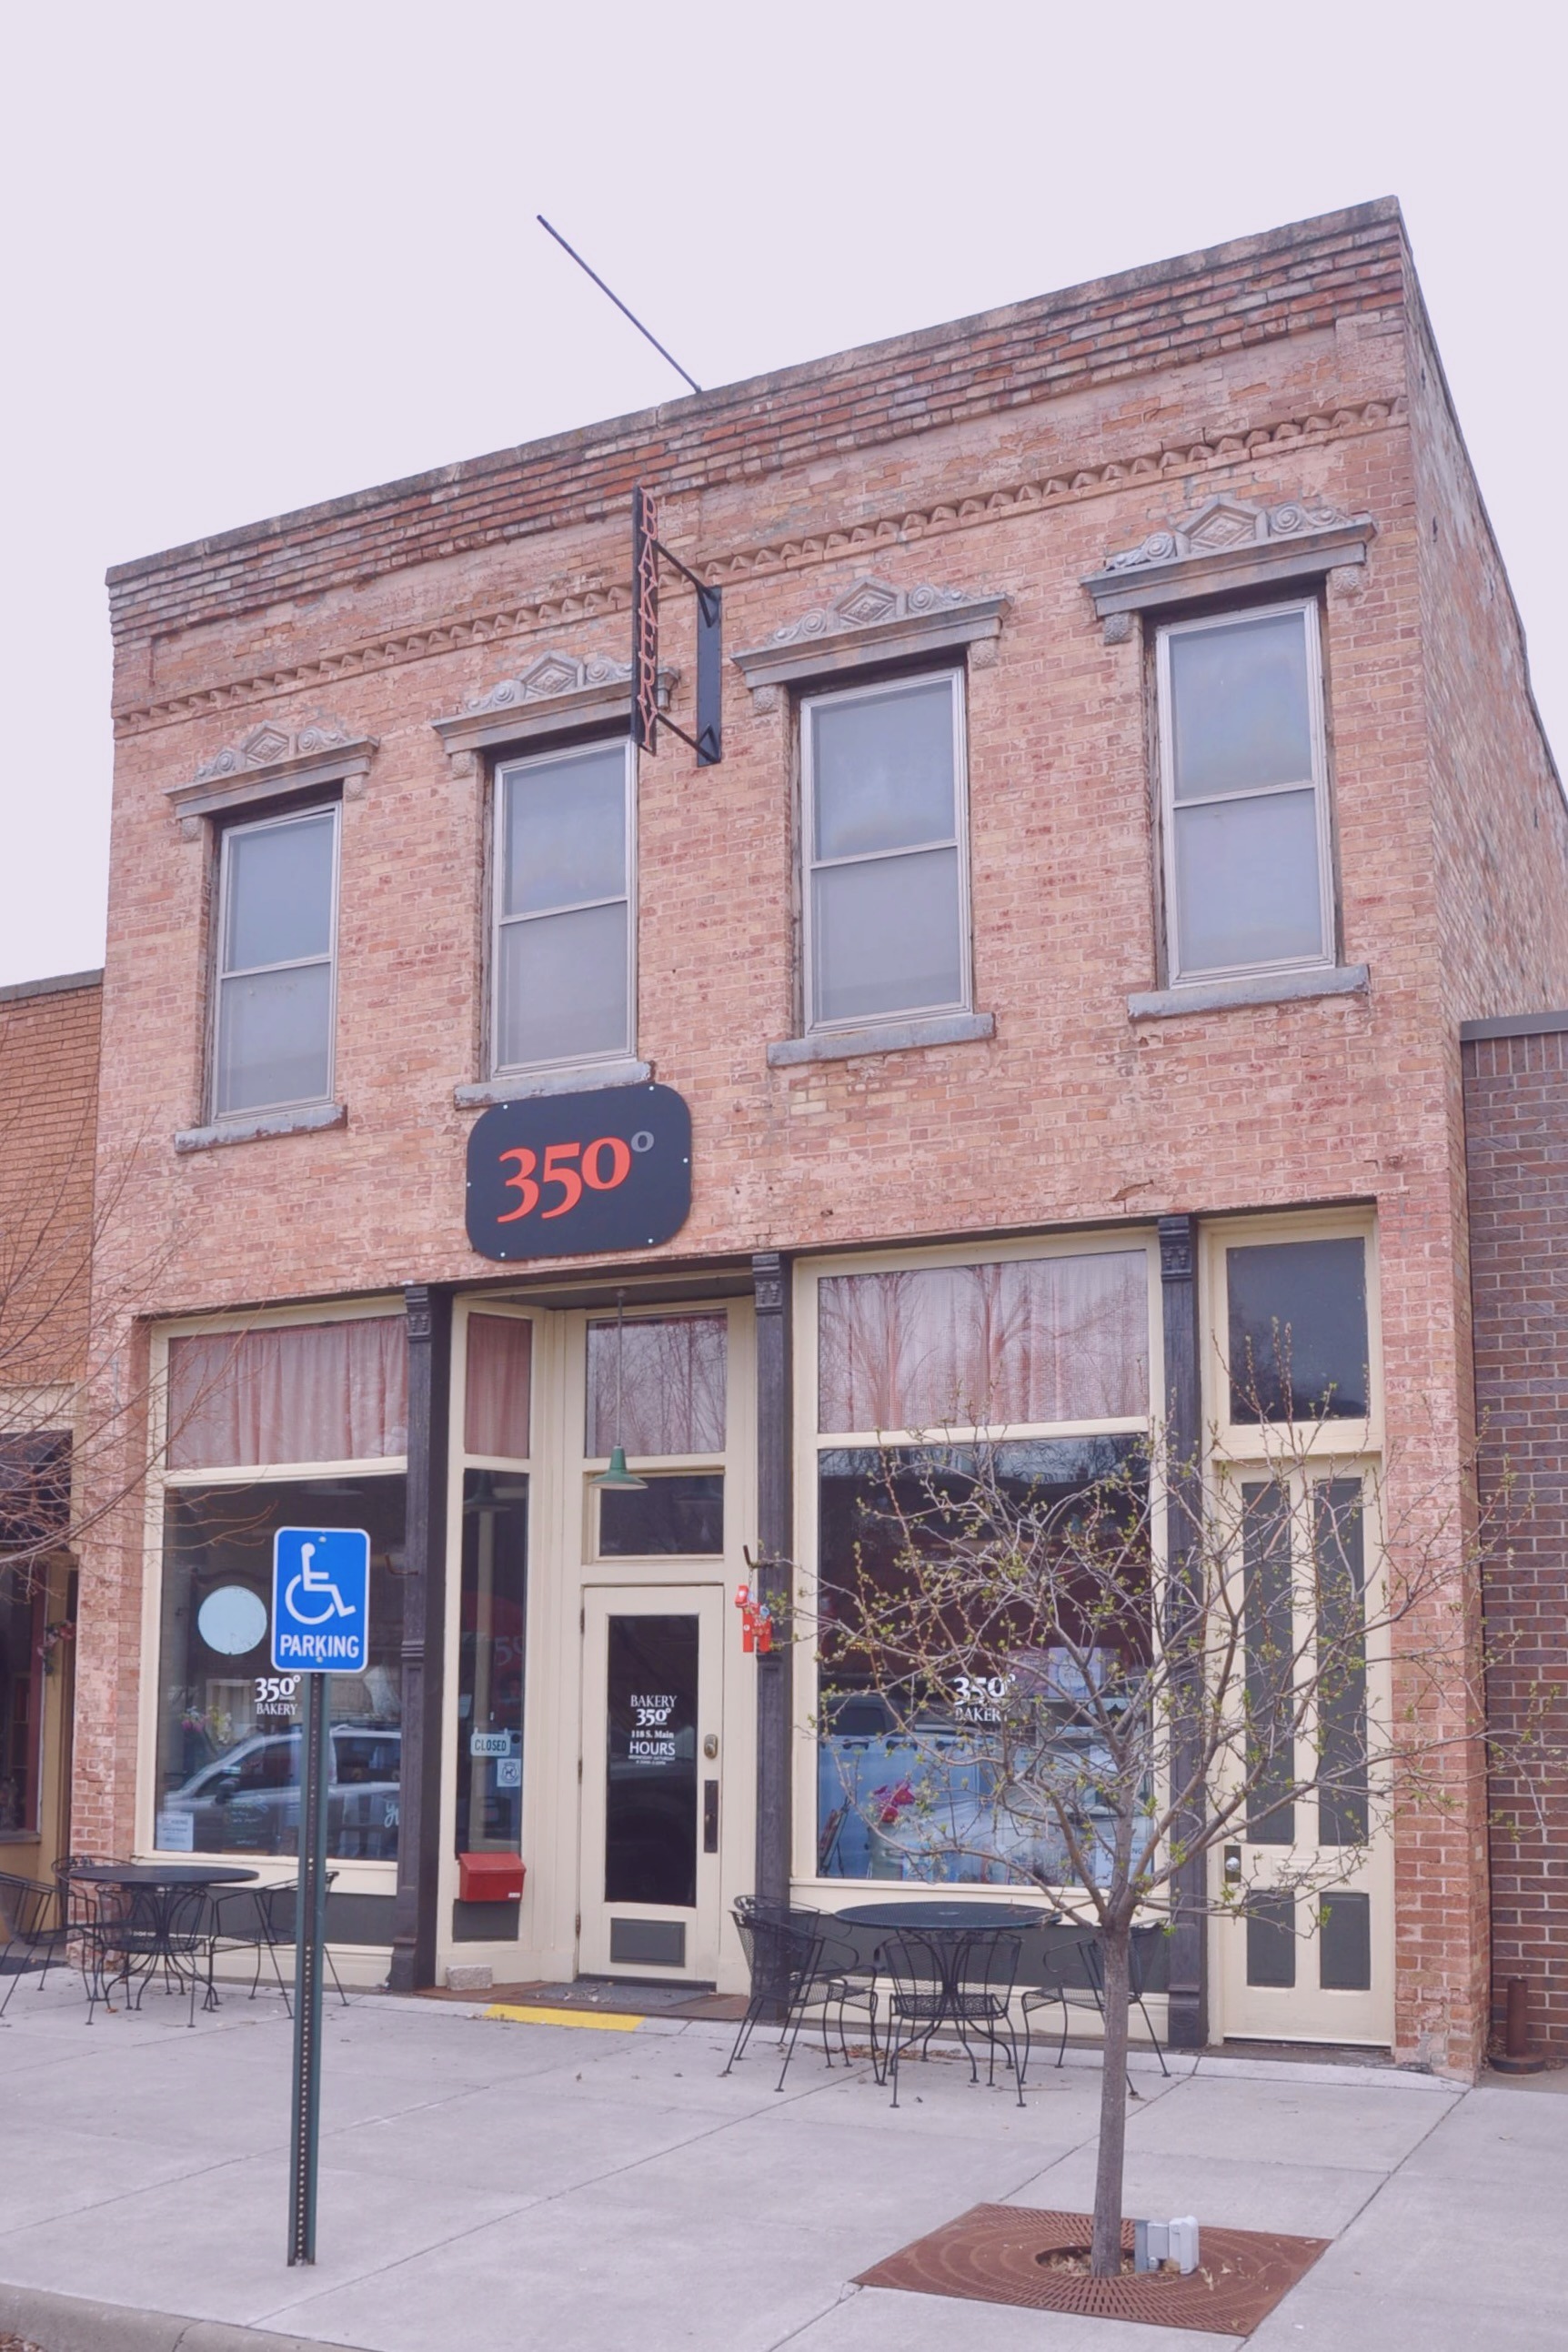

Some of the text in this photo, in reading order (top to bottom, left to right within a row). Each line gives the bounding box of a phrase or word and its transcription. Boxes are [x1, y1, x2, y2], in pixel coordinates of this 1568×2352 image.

[638, 487, 659, 752] BAKERY
[279, 1633, 359, 1658] PARKING
[254, 1674, 301, 1703] 350°
[630, 1694, 678, 1708] BAKERY
[256, 1703, 297, 1715] BAKERY
[636, 1707, 672, 1726] 350°
[654, 1730, 675, 1739] Main
[475, 1739, 507, 1752] CLOSED
[629, 1741, 676, 1756] HOURS
